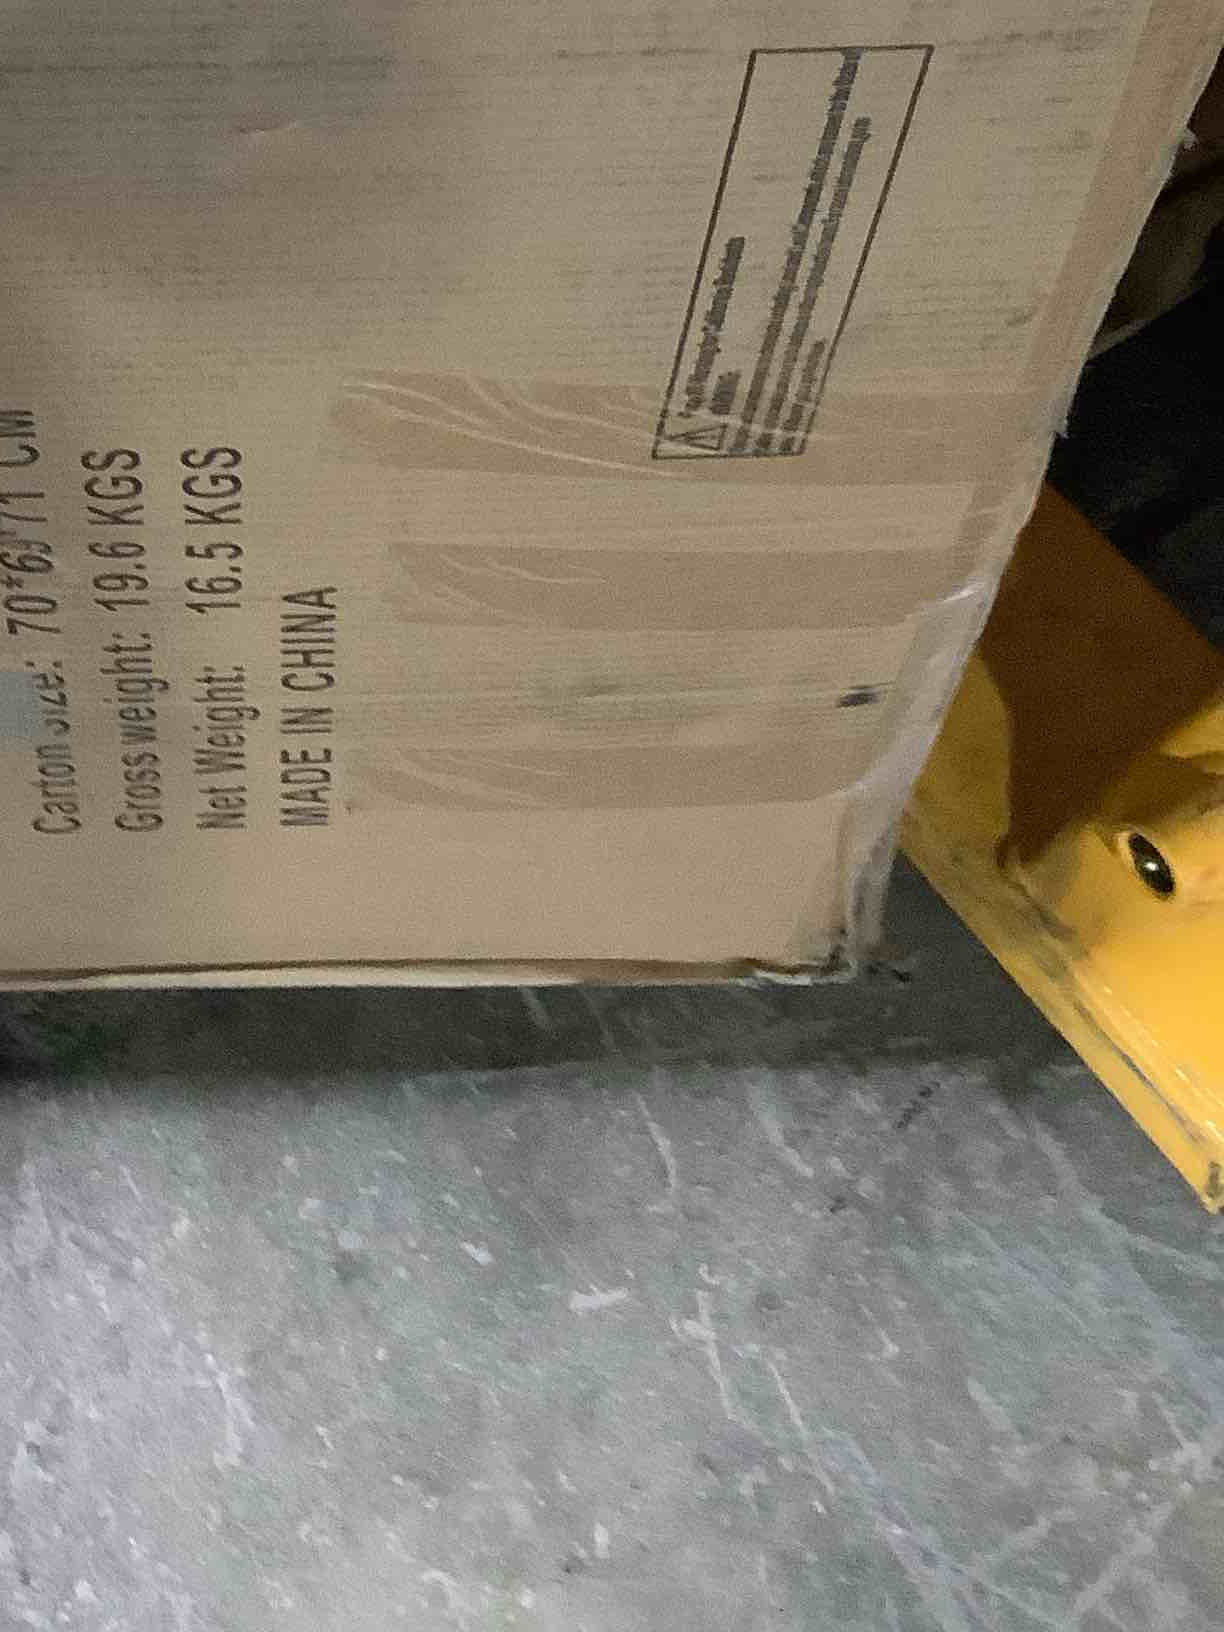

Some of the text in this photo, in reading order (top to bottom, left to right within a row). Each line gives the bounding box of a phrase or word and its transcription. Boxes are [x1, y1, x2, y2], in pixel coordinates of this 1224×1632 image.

[28, 742, 82, 835] Carton
[80, 447, 170, 832] Gross weight: 19.6 KGS
[180, 446, 261, 831] Net Weight: 16.5 KGS
[279, 585, 338, 828] MADE IN CHINA
